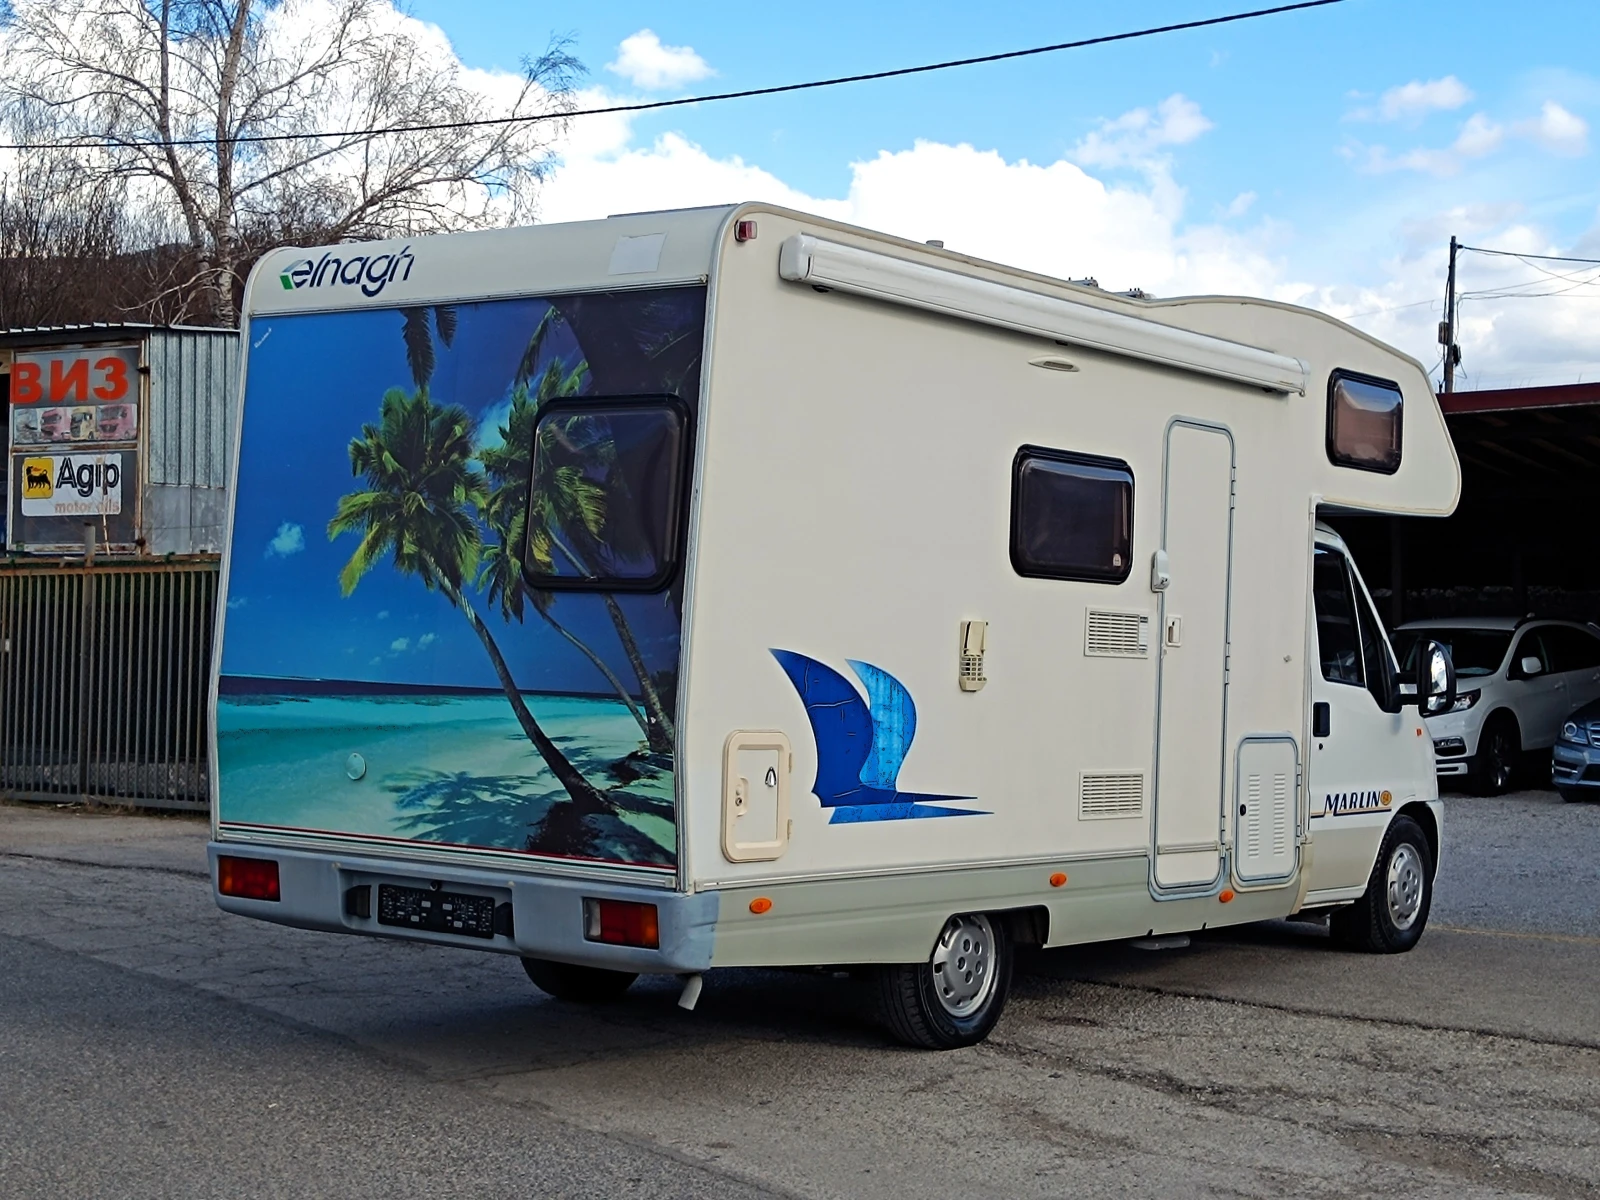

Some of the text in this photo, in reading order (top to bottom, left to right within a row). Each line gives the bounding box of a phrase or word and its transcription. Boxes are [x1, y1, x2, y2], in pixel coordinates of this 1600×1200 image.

[55, 457, 120, 498] Agip
[55, 501, 92, 513] motor
[1323, 790, 1381, 816] MARLIN
